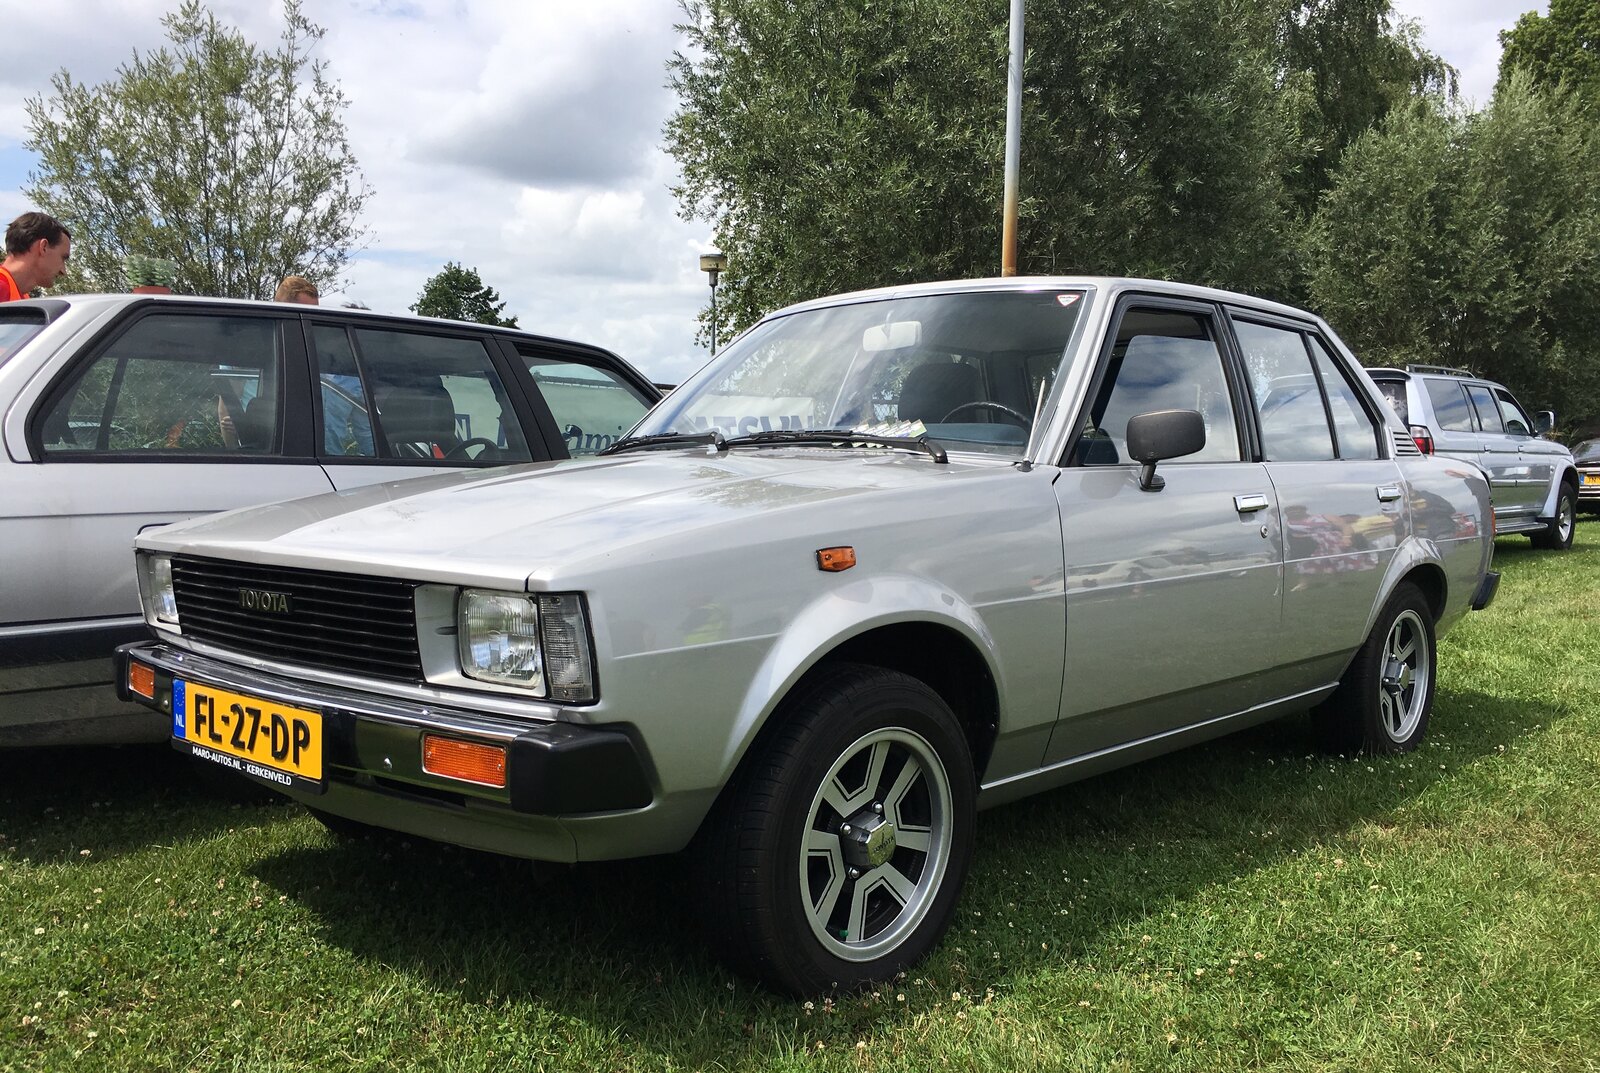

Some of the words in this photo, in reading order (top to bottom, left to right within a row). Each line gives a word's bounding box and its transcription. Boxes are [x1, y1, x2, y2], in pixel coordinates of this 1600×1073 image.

[240, 589, 289, 613] TOYOTA
[175, 713, 184, 728] NL
[194, 693, 310, 766] FL-27-DP
[192, 746, 242, 771] MARO-AUTOS.NL
[246, 763, 292, 786] KERKENVELD
